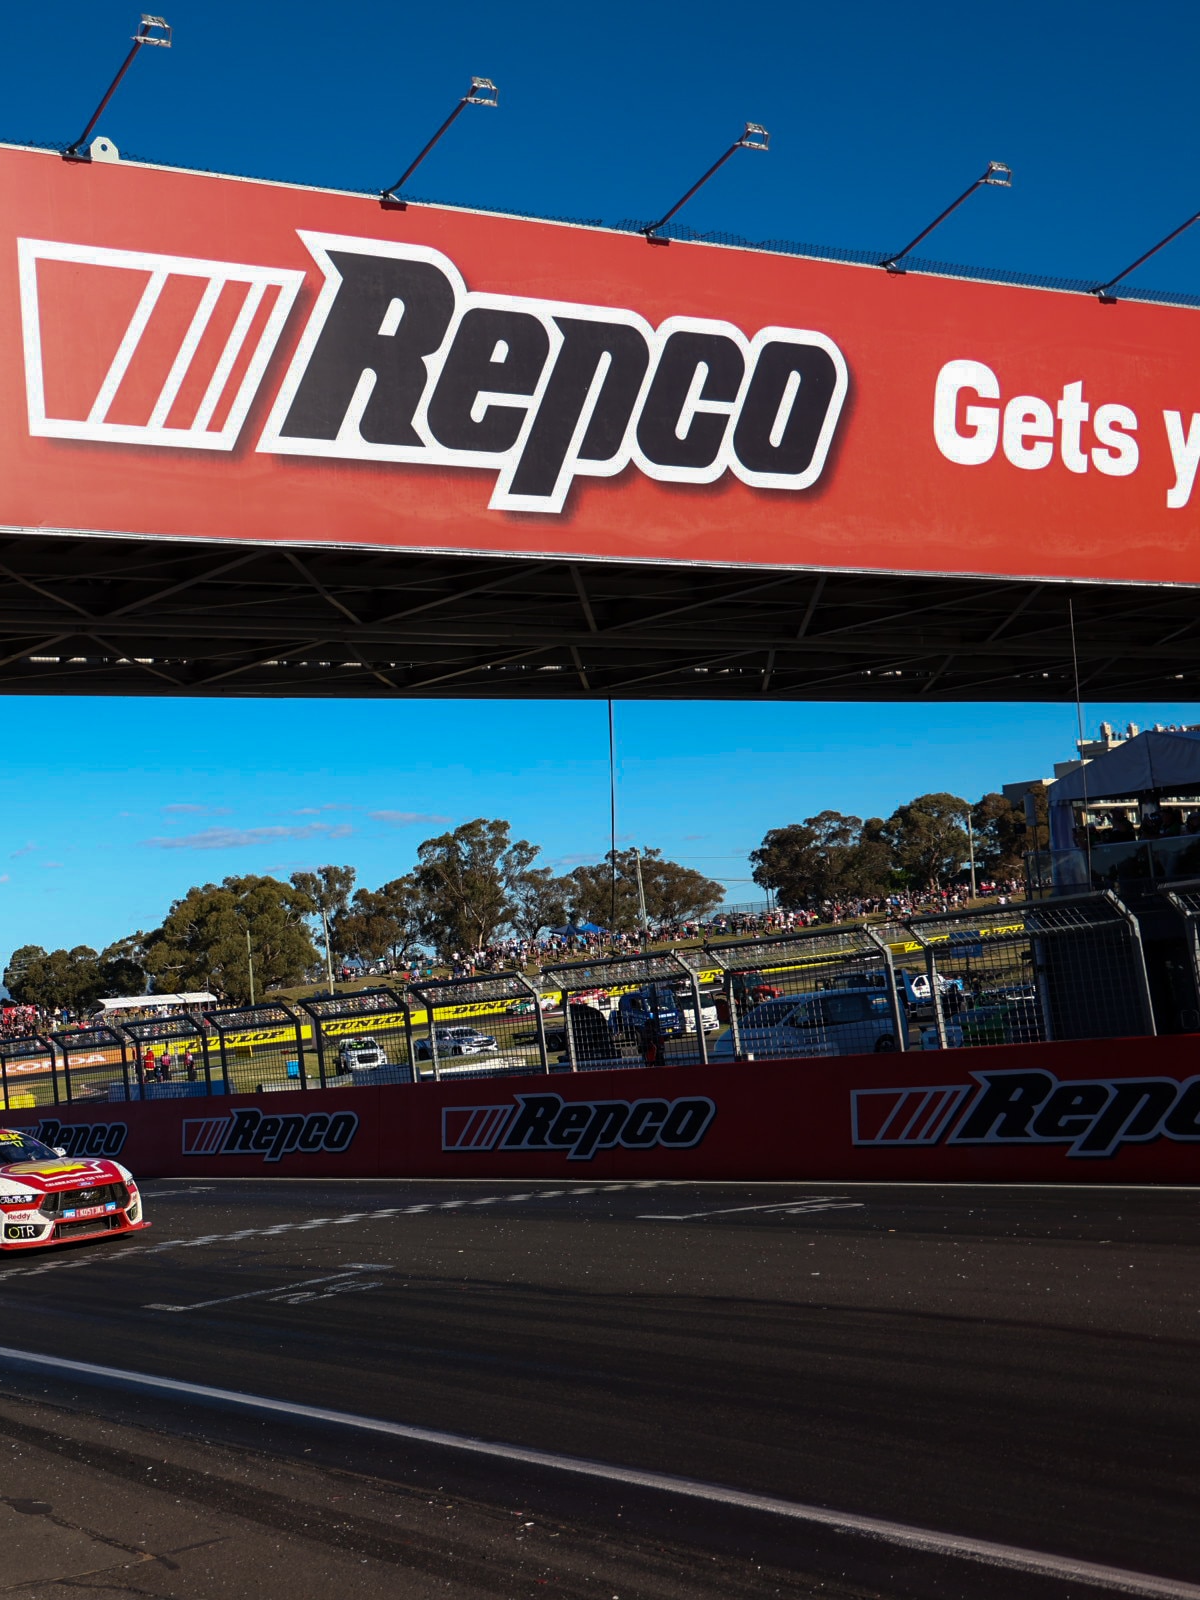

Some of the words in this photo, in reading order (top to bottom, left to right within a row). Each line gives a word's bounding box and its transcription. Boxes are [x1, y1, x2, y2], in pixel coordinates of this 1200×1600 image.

[257, 229, 850, 514] Repco
[933, 359, 1140, 477] Gets
[219, 1107, 359, 1162] Repco
[497, 1092, 717, 1160] Repco
[8, 1224, 36, 1239] OTR
